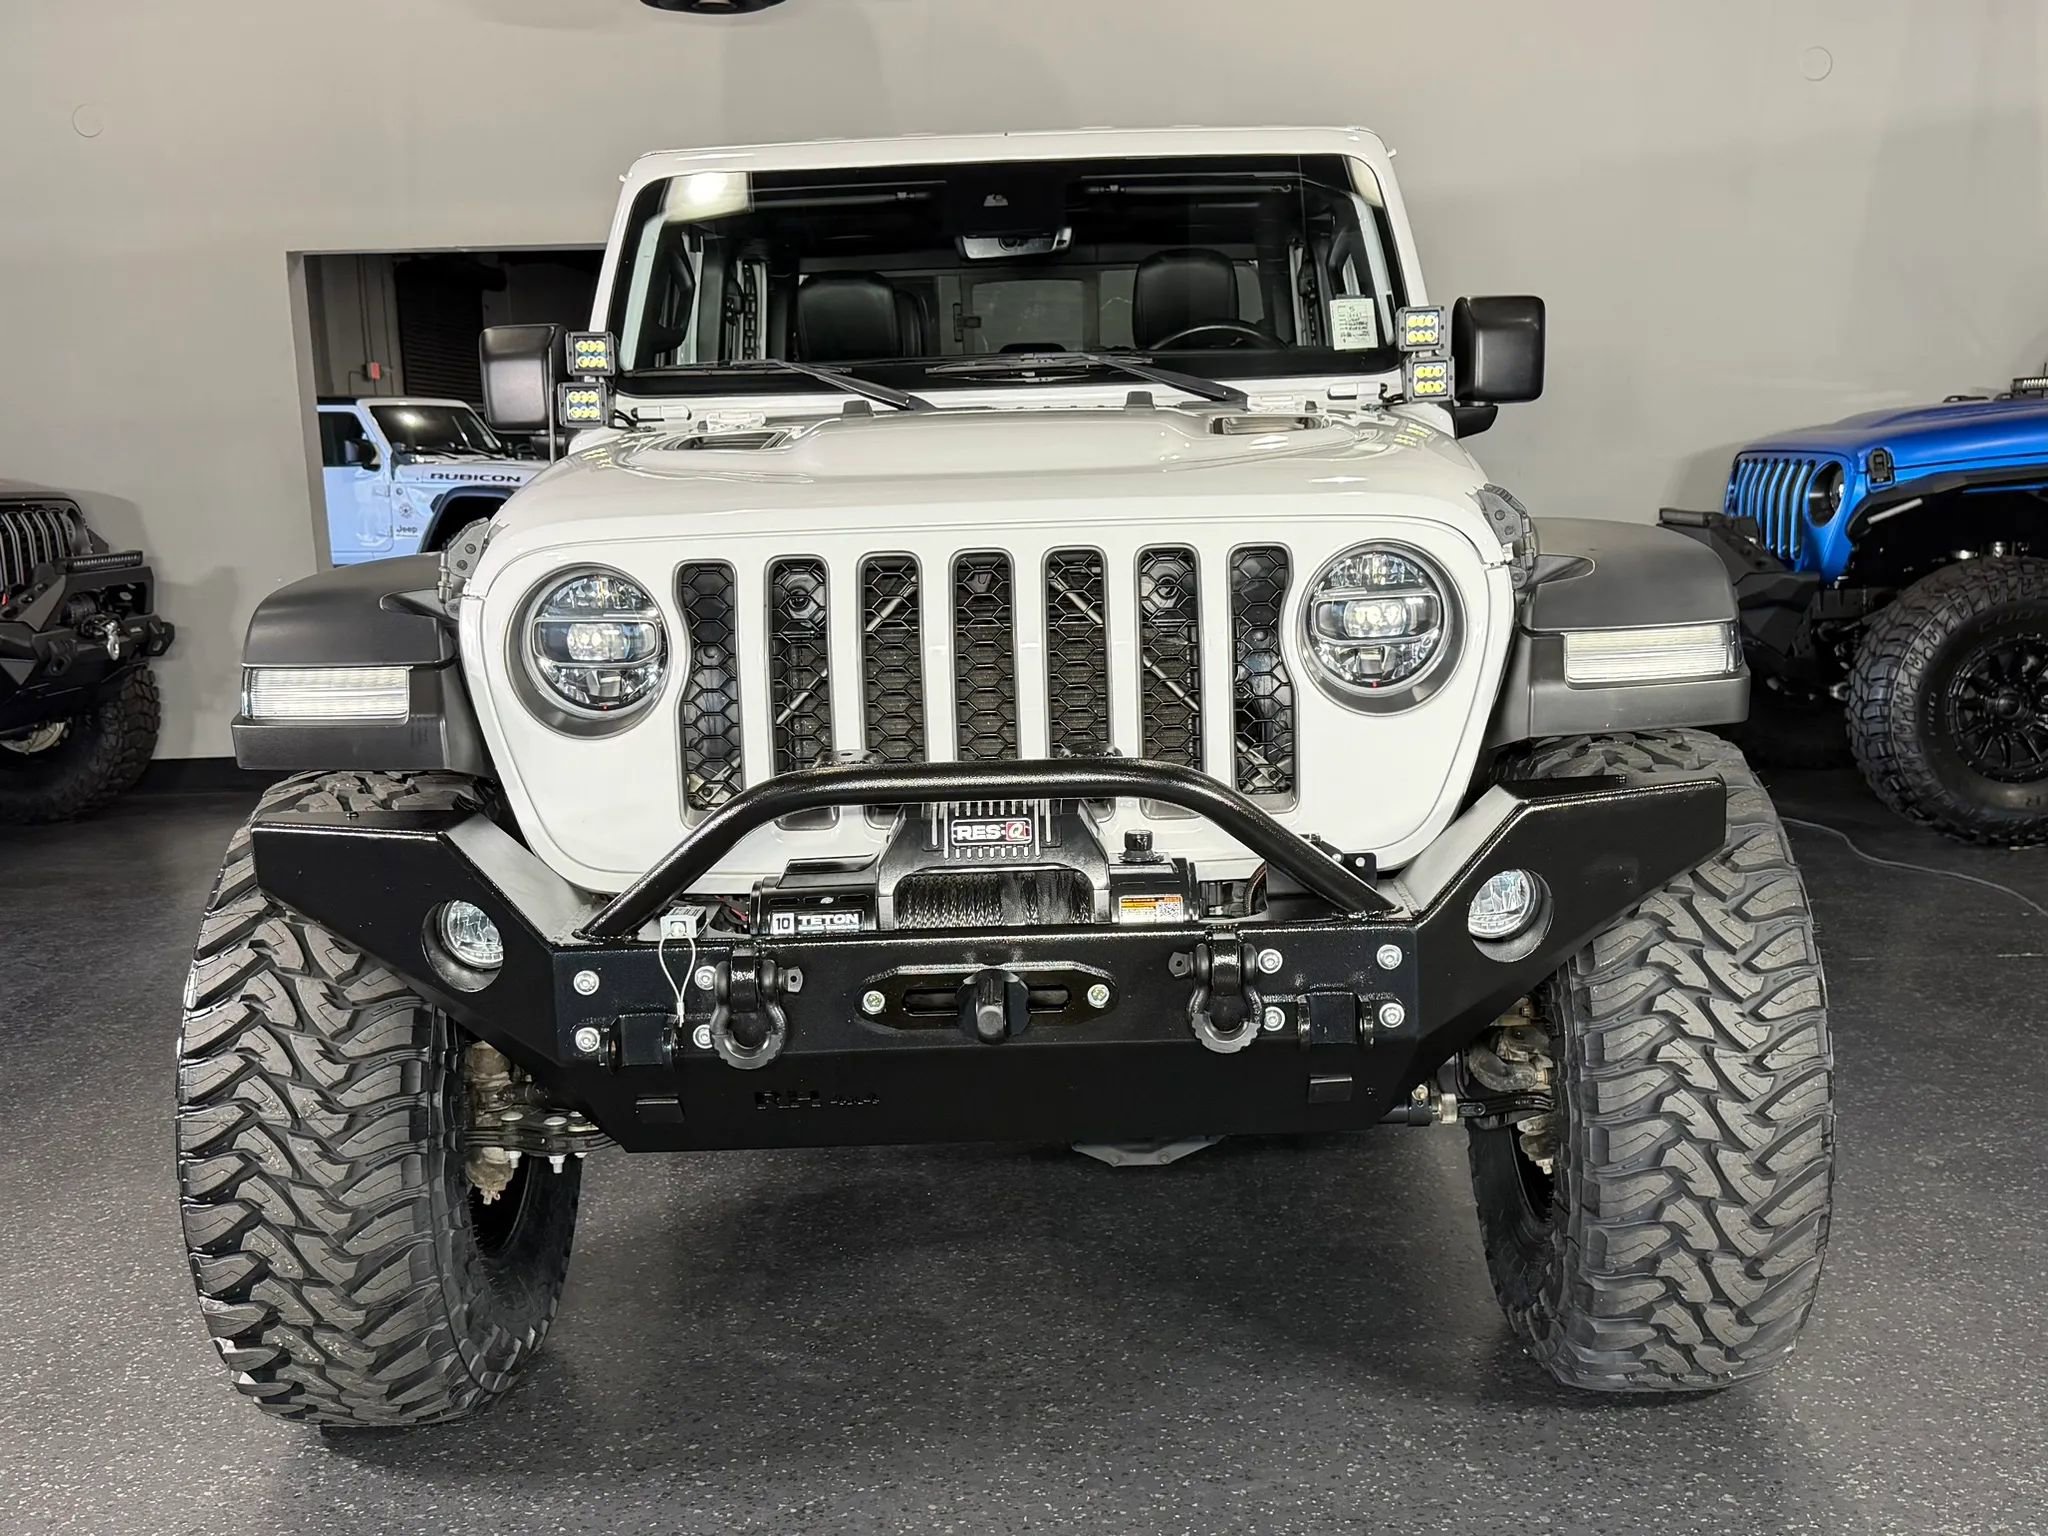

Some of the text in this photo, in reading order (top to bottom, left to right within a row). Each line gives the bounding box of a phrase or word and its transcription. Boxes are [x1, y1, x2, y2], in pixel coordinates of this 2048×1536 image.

[430, 472, 521, 482] RUBICON
[396, 525, 418, 533] Jeep
[775, 917, 791, 930] 10
[798, 914, 859, 925] TETON
